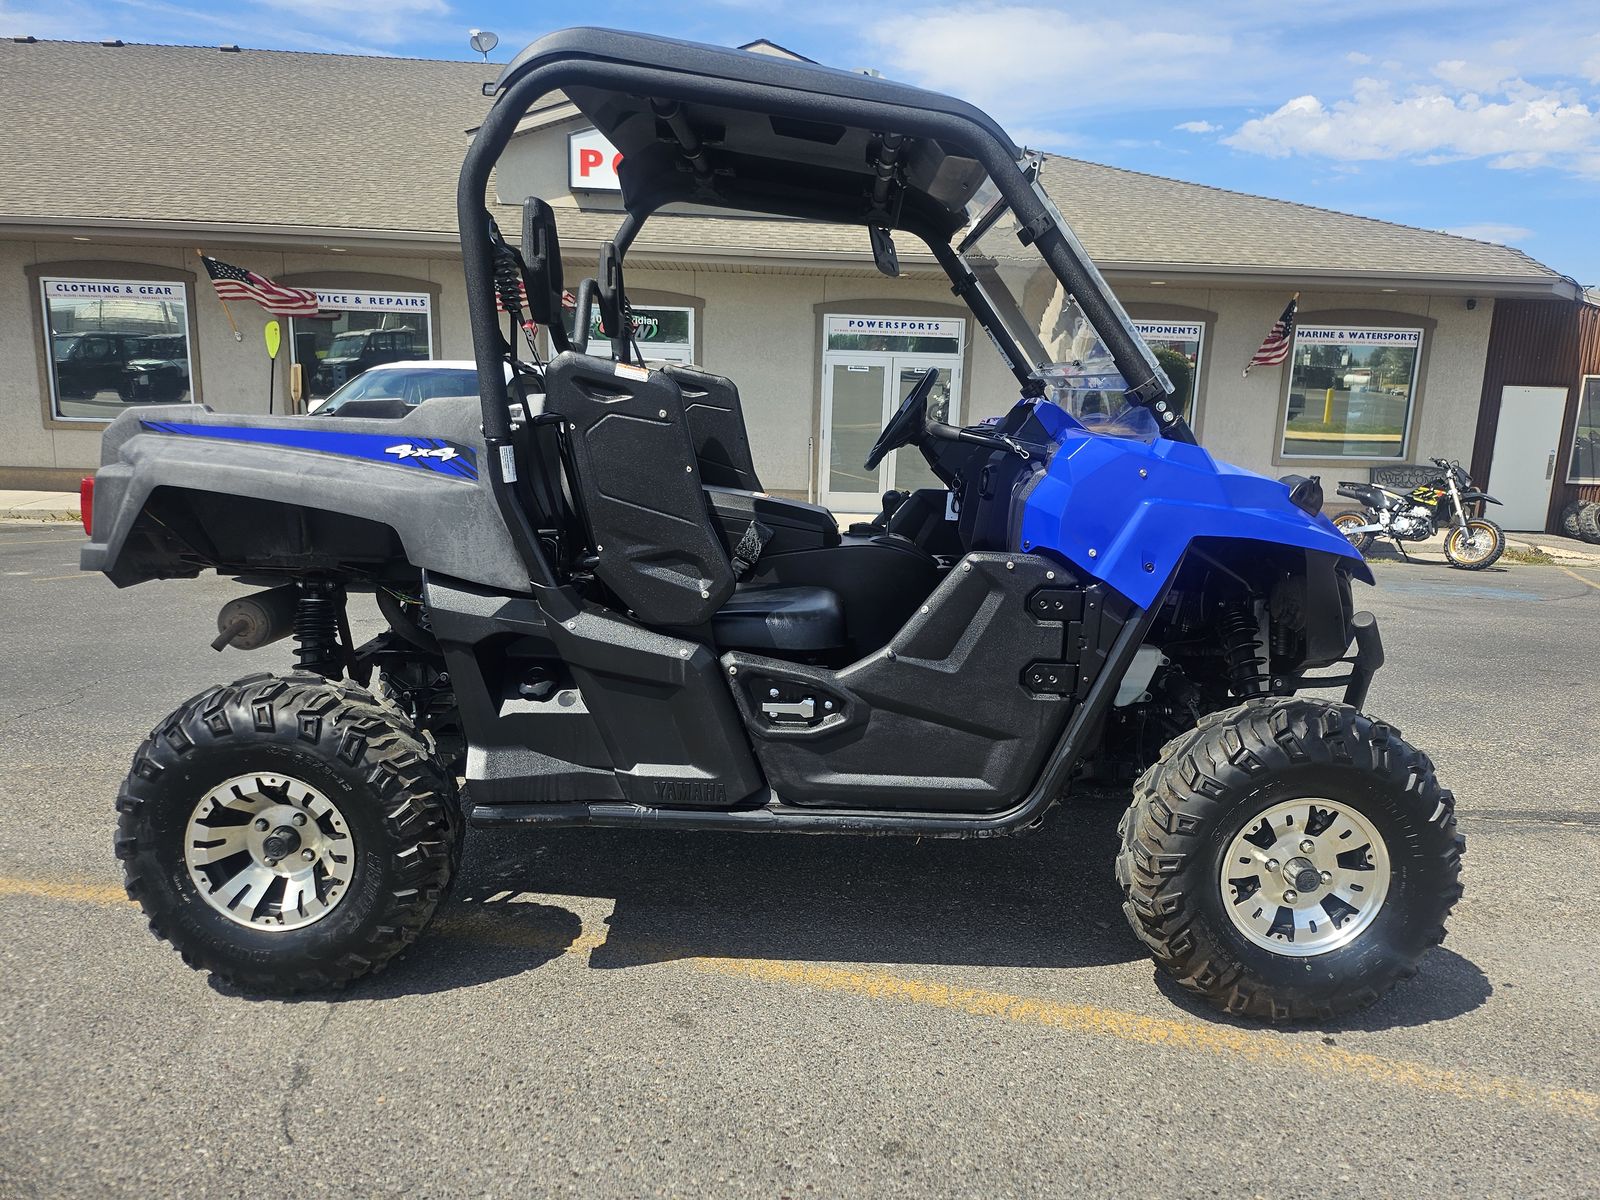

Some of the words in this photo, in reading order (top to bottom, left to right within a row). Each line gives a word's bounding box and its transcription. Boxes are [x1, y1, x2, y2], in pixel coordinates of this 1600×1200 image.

[56, 284, 120, 294] CLOTHING
[126, 286, 134, 295] &
[139, 286, 173, 295] GEAR
[354, 297, 362, 305] &
[370, 297, 426, 307] REPAIRS
[848, 320, 940, 331] POWERSPORTS
[1296, 330, 1335, 340] MARINE
[1338, 332, 1345, 340] &
[1348, 331, 1419, 341] WATERSPORTS
[653, 781, 727, 802] YAMAHA
